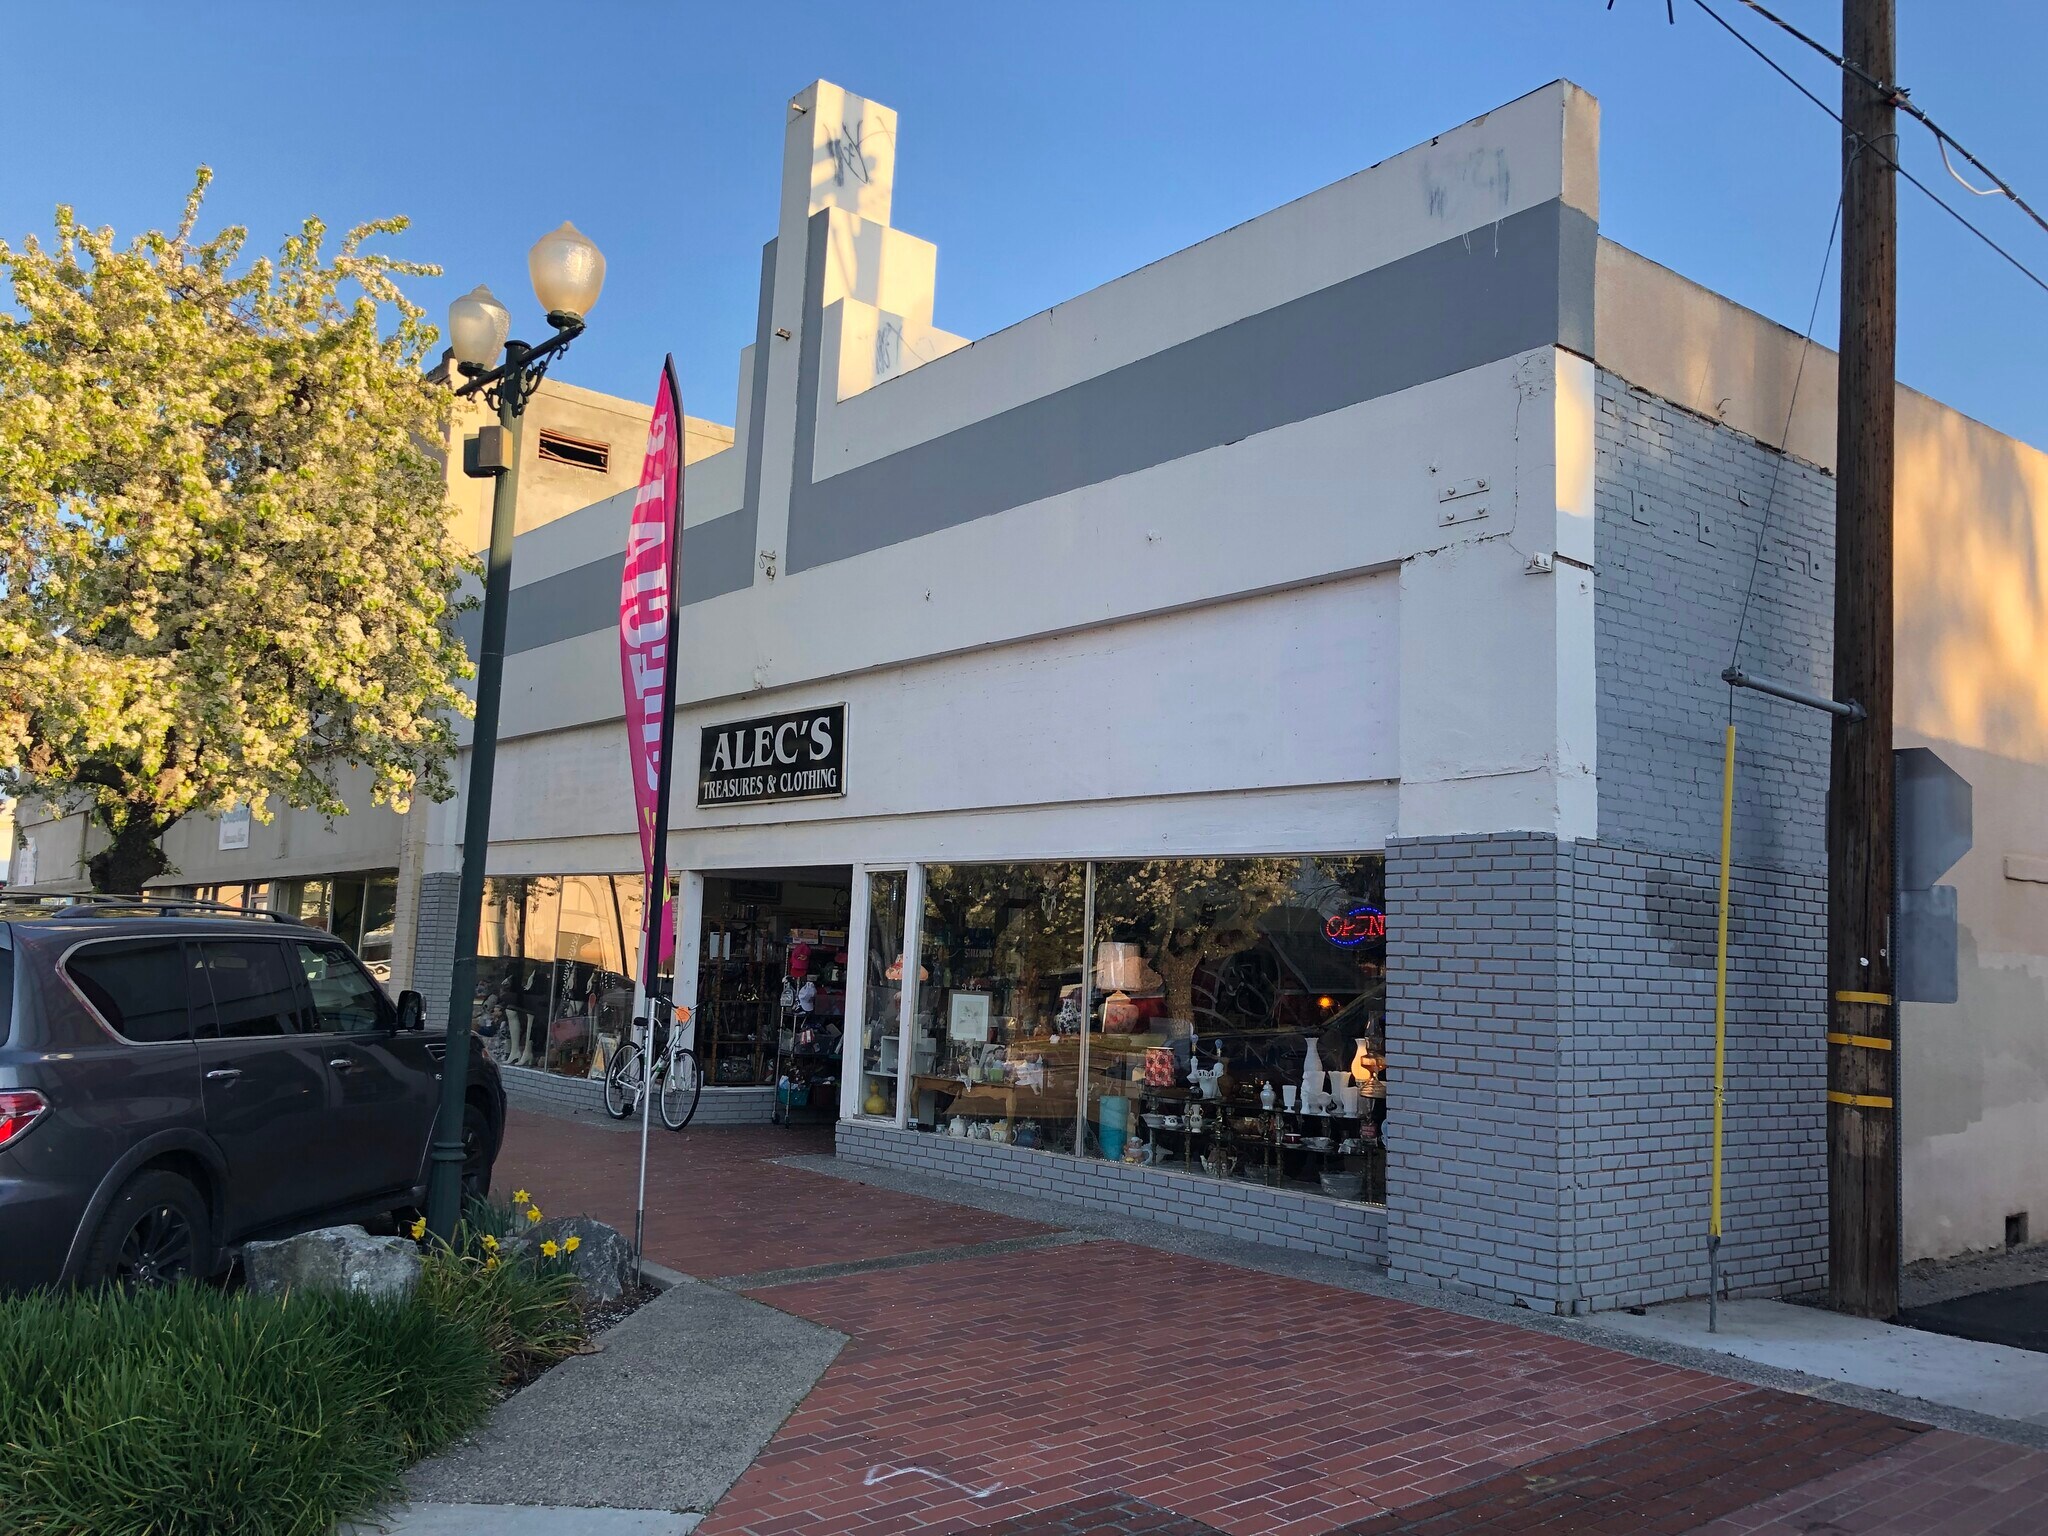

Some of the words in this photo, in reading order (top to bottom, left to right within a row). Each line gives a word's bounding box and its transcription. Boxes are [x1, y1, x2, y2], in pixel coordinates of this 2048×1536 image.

[710, 716, 834, 772] ALEC'S
[704, 775, 764, 799] TREASURES
[766, 774, 777, 794] &
[780, 767, 837, 792] CLOTHING
